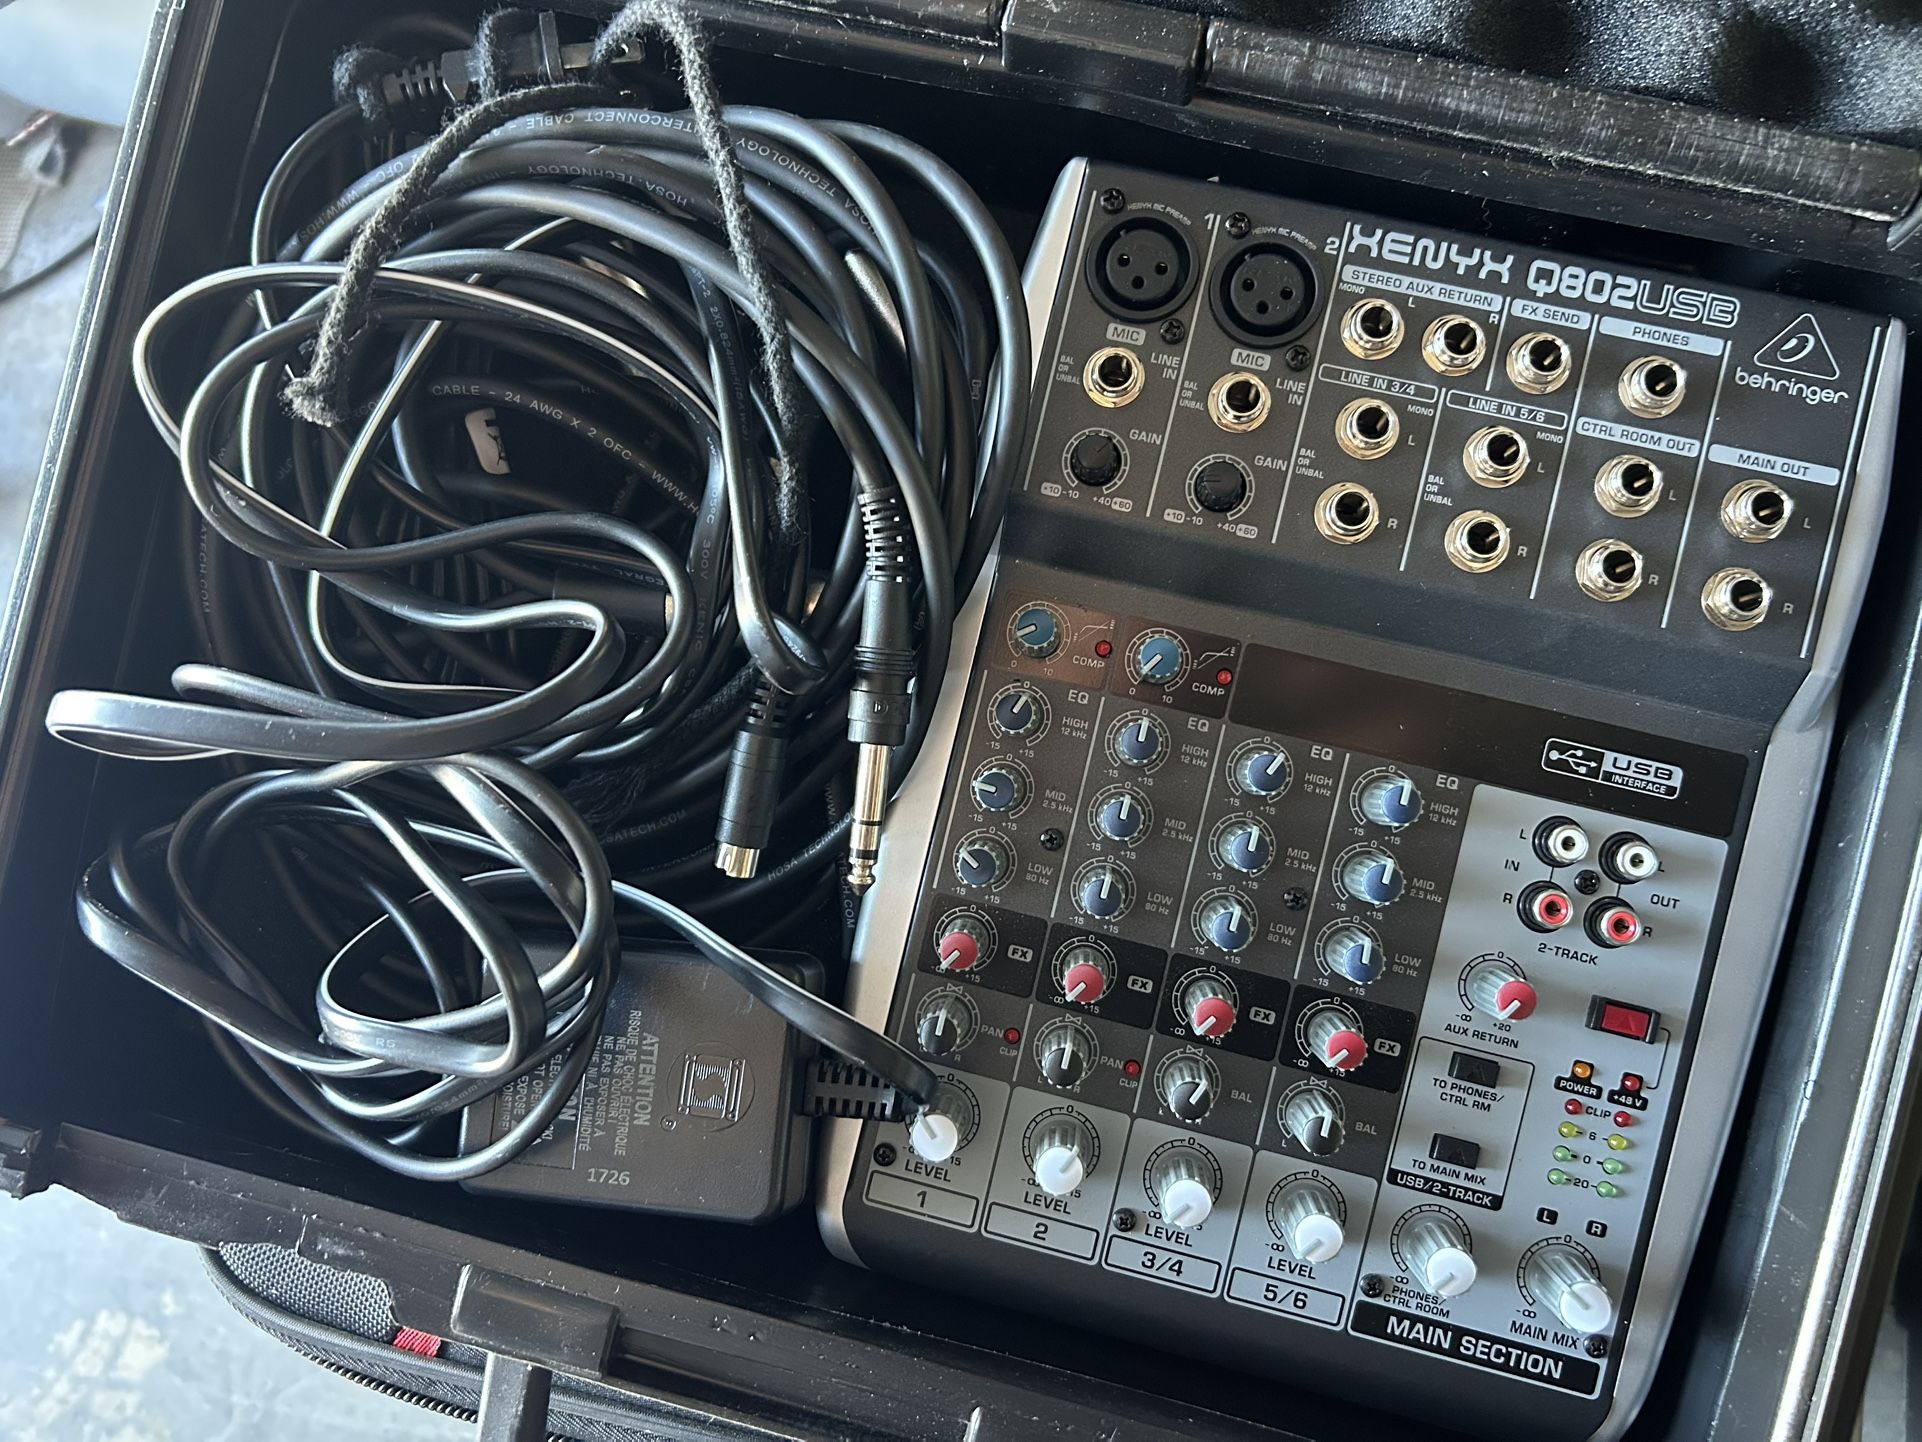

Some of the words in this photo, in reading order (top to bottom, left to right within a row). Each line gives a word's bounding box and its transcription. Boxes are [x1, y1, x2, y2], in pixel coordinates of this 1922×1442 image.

[526, 113, 574, 130] CABLE
[736, 136, 837, 197] TECHNOLOGY
[1204, 212, 1215, 230] 1
[1325, 237, 1339, 255] 2
[1348, 224, 1514, 283] XENYX
[1526, 259, 1741, 328] Q802USB
[1338, 282, 1365, 295] MONO
[1351, 270, 1401, 289] STEREO
[1406, 280, 1436, 296] AUX
[1439, 287, 1493, 307] RETURN
[1407, 297, 1415, 308] L
[1489, 313, 1499, 325] R
[1521, 304, 1538, 317] FX
[1542, 309, 1580, 325] SEND
[1111, 325, 1140, 342] MIC
[1632, 327, 1690, 346] PHONES
[1059, 355, 1075, 365] BAL
[1151, 352, 1181, 368] LINE
[1235, 351, 1265, 368] MIC
[1056, 372, 1081, 385] UNBAL
[1162, 367, 1177, 381] IN
[1183, 380, 1199, 391] BAL
[1275, 378, 1306, 393] LINE
[1340, 372, 1370, 387] LINE
[1373, 378, 1387, 390] IN
[1390, 381, 1416, 396] 3/4
[1735, 367, 1849, 405] behringer
[1179, 398, 1205, 411] UNBAL
[1287, 392, 1303, 406] IN
[1407, 405, 1434, 417] MONO
[1468, 399, 1499, 414] LINE
[1502, 405, 1516, 417] IN
[1519, 408, 1546, 423] 5/6
[432, 385, 480, 397] CABLE
[504, 392, 521, 403] 24
[529, 400, 563, 419] AWG
[569, 418, 581, 429] X
[588, 428, 597, 437] 2
[603, 438, 632, 461] OFC
[1129, 429, 1162, 445] GAIN
[1536, 431, 1564, 444] MONO
[1581, 421, 1615, 438] CTRL
[1620, 429, 1662, 447] ROOM
[1667, 439, 1695, 453] OUT
[1299, 448, 1316, 458] BAL
[1254, 456, 1288, 471] GAIN
[1737, 454, 1775, 471] MAIN
[1781, 462, 1811, 477] OUT
[1295, 467, 1325, 479] UNBAL
[1428, 475, 1445, 485] BAL
[1423, 494, 1453, 506] UNBAL
[1387, 518, 1398, 529] R
[1517, 546, 1527, 557] R
[1649, 575, 1659, 585] R
[1783, 603, 1794, 614] R
[1072, 655, 1105, 669] COMP
[1192, 682, 1225, 697] COMP
[1067, 689, 1090, 705] EQ
[1062, 716, 1089, 729] HIGH
[1188, 717, 1210, 732] EQ
[1182, 744, 1209, 757] HIGH
[1310, 745, 1333, 761] EQ
[1611, 757, 1673, 781] USB
[1304, 772, 1333, 786] HIGH
[1436, 774, 1459, 790] EQ
[1611, 774, 1667, 794] INTERFACE
[1045, 789, 1066, 801] MID
[1303, 783, 1313, 792] 12
[1315, 786, 1331, 796] kHz
[1430, 802, 1459, 816] HIGH
[1164, 817, 1187, 830] MID
[1428, 813, 1439, 821] 12
[1441, 816, 1457, 826] kHz
[1519, 828, 1527, 839] L
[1286, 848, 1310, 860] MID
[1028, 862, 1053, 875] LOW
[1284, 858, 1299, 868] 2.5
[1301, 862, 1317, 873] kHz
[1504, 859, 1520, 871] IN
[1411, 878, 1435, 890] MID
[1147, 892, 1173, 905] LOW
[1503, 892, 1513, 904] R
[1650, 894, 1680, 909] OUT
[1269, 922, 1296, 936] LOW
[1643, 926, 1653, 937] R
[1011, 947, 1029, 959] FX
[1538, 942, 1599, 965] 2-TRACK
[1394, 954, 1422, 967] LOW
[1130, 978, 1150, 991] FX
[1253, 1010, 1272, 1022] FX
[627, 1010, 642, 1045] RISQUE
[981, 1025, 1004, 1039] PAN
[1492, 1022, 1512, 1032] +20
[602, 1035, 613, 1050] NE
[1444, 1023, 1469, 1036] AUX
[1471, 1029, 1519, 1049] RETURN
[615, 1037, 626, 1051] NE
[1378, 1041, 1397, 1054] FX
[626, 1048, 637, 1061] DE
[1000, 1047, 1018, 1056] CLIP
[601, 1053, 612, 1074] PAS
[612, 1054, 624, 1074] PAS
[1100, 1056, 1124, 1069] PAN
[587, 1066, 598, 1079] NI
[621, 1064, 635, 1091] CHOC
[633, 1032, 659, 1126] ATTENTION
[1119, 1078, 1138, 1089] CLIP
[1432, 1077, 1446, 1089] TO
[1450, 1081, 1504, 1103] PHONES/
[1560, 1080, 1598, 1096] POWER
[595, 1077, 609, 1126] EXPOSER
[1231, 1089, 1252, 1103] BAL
[1440, 1092, 1468, 1107] CTRL
[1472, 1101, 1492, 1112] RM
[1612, 1094, 1633, 1104] +48
[1635, 1099, 1643, 1107] V
[500, 1082, 515, 1132] OISTURE!
[1585, 1105, 1612, 1119] CLIP
[1355, 1122, 1377, 1135] BAL
[1589, 1132, 1597, 1141] 6
[1583, 1155, 1591, 1164] 0
[586, 1168, 630, 1186] 1726
[904, 1159, 952, 1183] LEVEL
[1412, 1159, 1427, 1170] TO
[1429, 1163, 1460, 1179] MAIN
[1464, 1171, 1486, 1186] MIX
[1573, 1177, 1589, 1188] 20
[1397, 1173, 1494, 1207] USB/2-TRACK
[916, 1190, 928, 1208] 1
[1023, 1191, 1071, 1214] LEVEL
[1543, 1211, 1552, 1222] L
[1033, 1222, 1048, 1241] 2
[1145, 1223, 1193, 1247] LEVEL
[1591, 1223, 1602, 1235] R
[1141, 1251, 1184, 1277] 3/4
[1267, 1256, 1316, 1280] LEVEL
[1263, 1283, 1309, 1310] 5/6
[1392, 1286, 1447, 1306] PHONES/
[1384, 1293, 1412, 1309] CTRL
[1415, 1302, 1450, 1319] ROOM
[1510, 1320, 1548, 1342] MAIN
[1552, 1331, 1579, 1350] MIX
[1386, 1316, 1452, 1349] MAIN
[1460, 1336, 1563, 1380] SECTION
